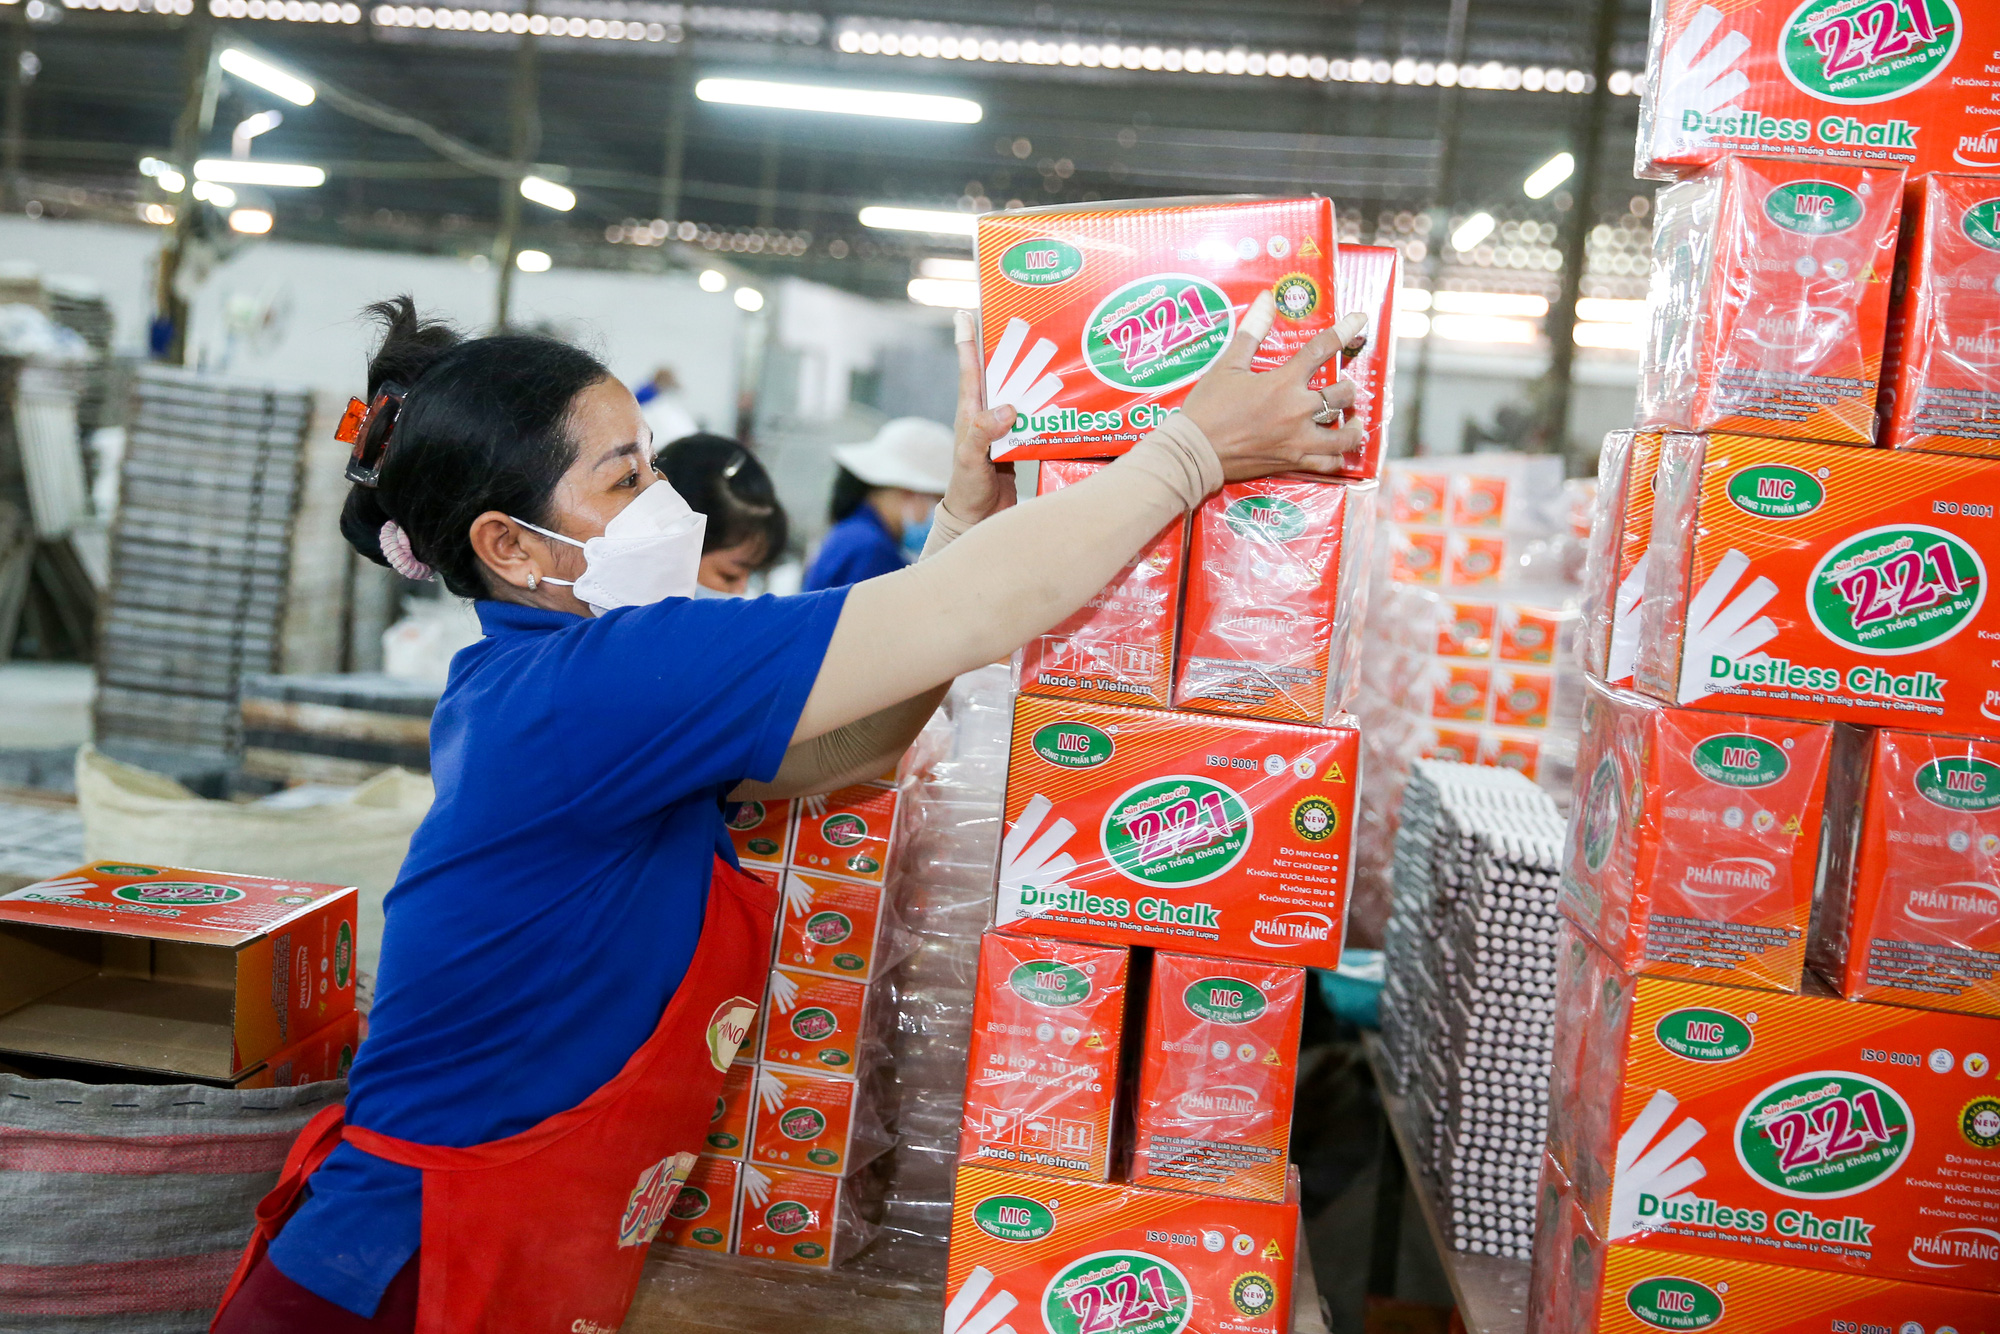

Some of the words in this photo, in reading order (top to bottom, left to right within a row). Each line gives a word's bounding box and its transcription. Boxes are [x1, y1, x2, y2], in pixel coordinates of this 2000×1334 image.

[1810, 0, 1937, 80] 221
[1829, 76, 1858, 92] Phấn
[1858, 65, 1890, 82] Trắng
[1891, 54, 1927, 70] Không
[1928, 45, 1946, 58] Bụi
[1682, 109, 1811, 142] Dustless
[1817, 116, 1921, 149] Chalk
[1795, 194, 1835, 216] MIC
[1026, 250, 1059, 270] MIC
[1010, 269, 1029, 281] CÔNG
[1030, 274, 1040, 282] TY
[1061, 266, 1075, 279] MIC
[1284, 293, 1306, 301] NEW
[1107, 285, 1215, 373] 221
[1757, 315, 1795, 335] PHẤN
[1131, 367, 1154, 384] Phấn
[1154, 357, 1181, 371] Trắng
[1180, 341, 1210, 359] Không
[1209, 330, 1225, 343] Bụi
[1012, 407, 1123, 433] Dustless
[1025, 437, 1047, 447] phẩm
[1065, 434, 1082, 444] xuất
[1083, 435, 1100, 443] theo
[1102, 433, 1112, 443] Hệ
[1114, 433, 1137, 442] Thống
[1758, 478, 1796, 500] MIC
[1737, 494, 1759, 511] CÔNG
[1760, 503, 1772, 512] TY
[1772, 502, 1795, 514] PHẤN
[1796, 501, 1812, 512] MIC
[1933, 501, 1958, 514] ISO
[1962, 503, 1993, 518] 9001
[1251, 507, 1283, 527] MIC
[1112, 585, 1127, 597] 10
[1838, 542, 1963, 629] 221
[1858, 626, 1885, 643] Phấn
[1886, 615, 1917, 633] Trắng
[1918, 604, 1953, 622] Không
[1954, 598, 1971, 611] Bụi
[1038, 673, 1077, 688] Made
[1080, 677, 1093, 689] in
[1096, 679, 1152, 695] Vietnam
[1710, 654, 1840, 692] Dustless
[1846, 666, 1948, 702] Chalk
[1058, 733, 1090, 753] MIC
[1040, 747, 1059, 762] CÔNG
[1060, 754, 1071, 763] TY
[1070, 754, 1090, 765] PHẤN
[1090, 753, 1104, 764] MIC
[1206, 755, 1229, 767] ISO
[1231, 759, 1258, 771] 9001
[1722, 747, 1760, 770] MIC
[1947, 770, 1987, 793] MIC
[1124, 803, 1138, 816] Sản
[1138, 796, 1160, 811] Phẩm
[1160, 791, 1175, 803] Cao
[1174, 785, 1190, 799] Cấp
[1301, 803, 1313, 815] SẢN
[1126, 791, 1234, 867] 221
[1304, 815, 1326, 824] NEW
[1298, 825, 1313, 839] CAO
[1315, 828, 1331, 840] CẤP
[1144, 862, 1168, 877] Phấn
[1167, 852, 1195, 868] Trắng
[1195, 843, 1226, 860] Không
[1226, 839, 1241, 853] Bụi
[1686, 865, 1723, 884] PHẤN
[1725, 869, 1770, 890] TRẮNG
[1020, 884, 1130, 919] Dustless
[1135, 896, 1222, 930] Chalk
[1909, 888, 1948, 909] PHẤN
[1951, 893, 1997, 915] TRẮNG
[812, 920, 845, 939] 221
[1031, 910, 1053, 921] phẩm
[1055, 914, 1069, 922] sản
[1070, 915, 1088, 925] xuất
[1089, 918, 1105, 927] theo
[1107, 920, 1118, 929] Hệ
[1119, 920, 1143, 933] Thống
[1143, 924, 1165, 934] Quản
[1166, 926, 1175, 935] Lý
[1176, 928, 1195, 937] Chất
[1196, 930, 1219, 941] Lượng
[1254, 917, 1287, 937] PHẤN
[1288, 921, 1328, 941] TRẮNG
[1035, 970, 1068, 992] MIC
[1210, 988, 1243, 1008] MIC
[798, 1015, 829, 1036] 221
[1686, 1021, 1724, 1043] MIC
[989, 1053, 1006, 1065] 50
[1008, 1055, 1037, 1069] HỘP
[1039, 1063, 1047, 1071] x
[1051, 1062, 1067, 1074] 10
[1069, 1064, 1099, 1078] VIÊN
[1861, 1048, 1887, 1062] ISO
[1890, 1052, 1921, 1067] 9001
[1066, 1080, 1084, 1090] 4.6
[1085, 1082, 1102, 1093] KG
[1181, 1092, 1213, 1110] PHẤN
[1215, 1094, 1254, 1113] TRẮNG
[786, 1116, 817, 1136] 221
[1765, 1088, 1890, 1172] 221
[1974, 1118, 2000, 1128] NEW
[977, 1145, 1016, 1161] Made
[1019, 1150, 1031, 1162] in
[1035, 1152, 1091, 1171] Vietnam
[1785, 1169, 1813, 1185] Phấn
[1814, 1161, 1845, 1176] Trắng
[1846, 1150, 1882, 1167] Không
[1882, 1145, 1899, 1157] Bụi
[999, 1206, 1031, 1226] MIC
[1638, 1193, 1767, 1232] Dustless
[1774, 1208, 1876, 1246] Chalk
[1146, 1231, 1168, 1242] ISO
[1171, 1234, 1197, 1246] 9001
[1913, 1235, 1951, 1256] PHẤN
[1953, 1238, 1999, 1261] TRẮNG
[1067, 1266, 1173, 1334] 221
[1243, 1291, 1264, 1299] NEW
[1657, 1289, 1696, 1312] MIC
[1831, 1320, 1857, 1333] ISO
